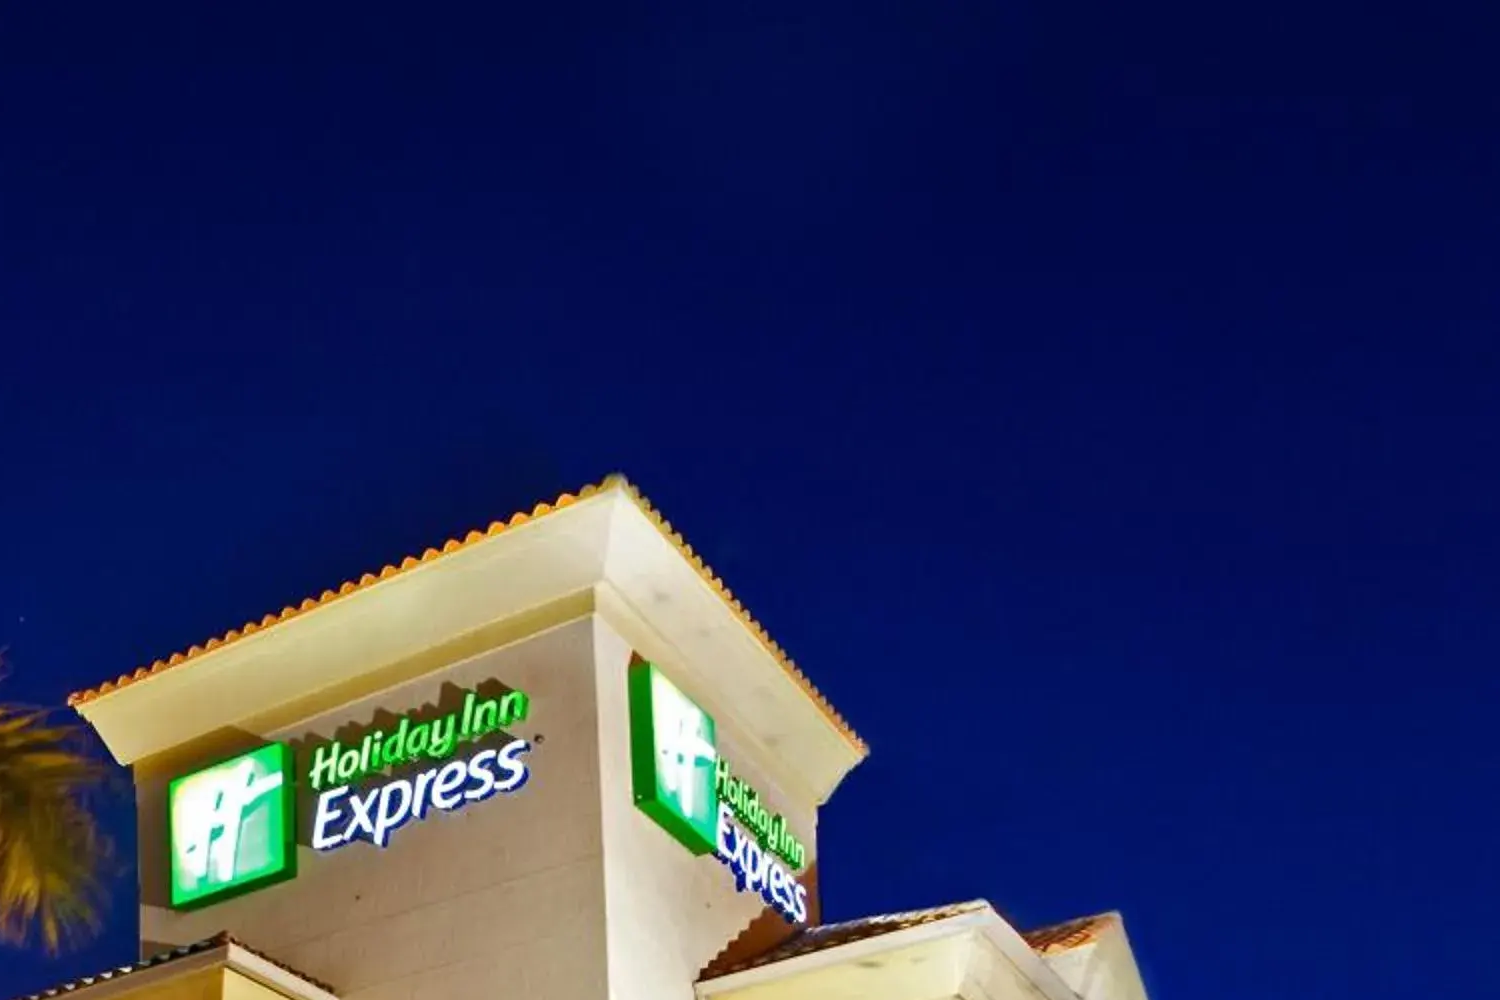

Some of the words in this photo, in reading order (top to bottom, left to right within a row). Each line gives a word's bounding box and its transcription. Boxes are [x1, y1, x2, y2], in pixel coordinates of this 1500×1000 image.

[309, 712, 456, 790] Holiday
[461, 688, 529, 738] Inn
[311, 738, 531, 852] Express
[714, 755, 780, 852] Holiday
[779, 817, 806, 870] Inn
[714, 801, 808, 924] Express
